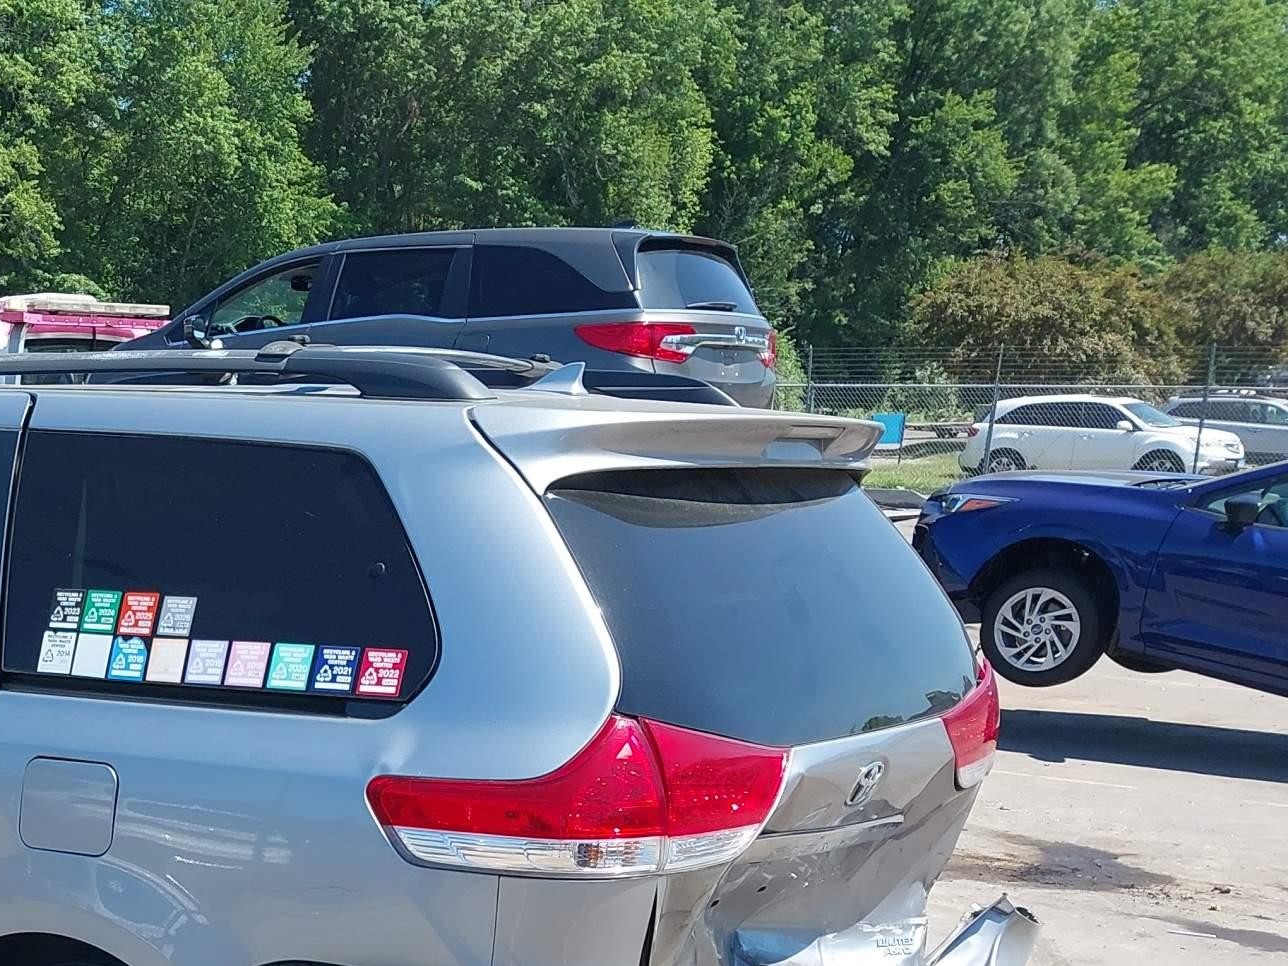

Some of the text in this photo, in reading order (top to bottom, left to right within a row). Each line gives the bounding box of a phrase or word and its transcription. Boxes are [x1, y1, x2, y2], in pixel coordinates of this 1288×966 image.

[64, 607, 80, 615] 2023
[288, 664, 308, 672] 2020
[333, 666, 352, 676] 2021
[378, 669, 399, 678] 2022
